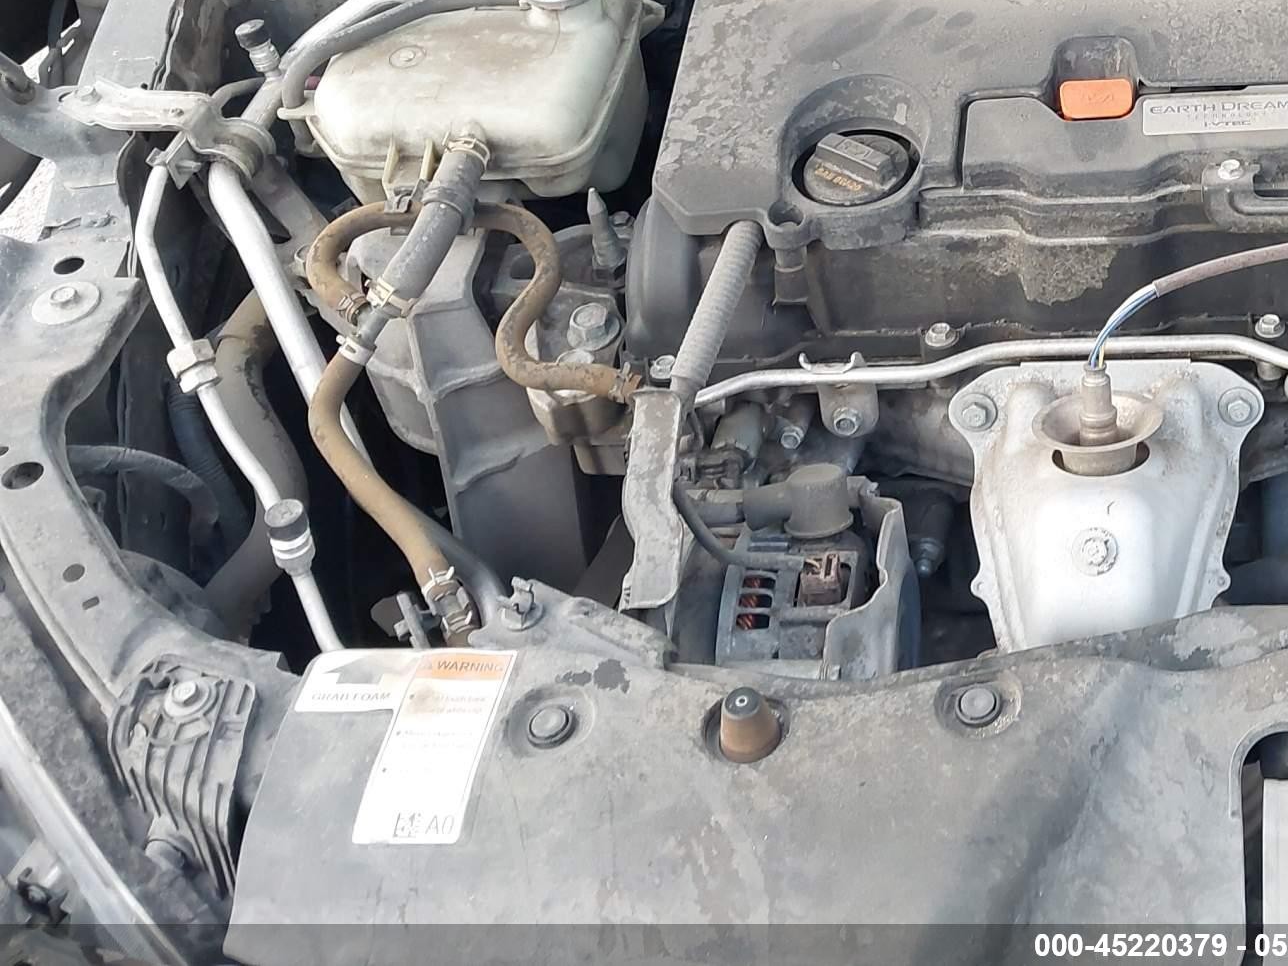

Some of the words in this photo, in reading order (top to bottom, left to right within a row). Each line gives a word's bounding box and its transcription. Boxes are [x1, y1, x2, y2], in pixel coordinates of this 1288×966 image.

[1150, 103, 1216, 115] EARTH
[437, 660, 504, 672] WARNING
[353, 691, 392, 702] FOAM
